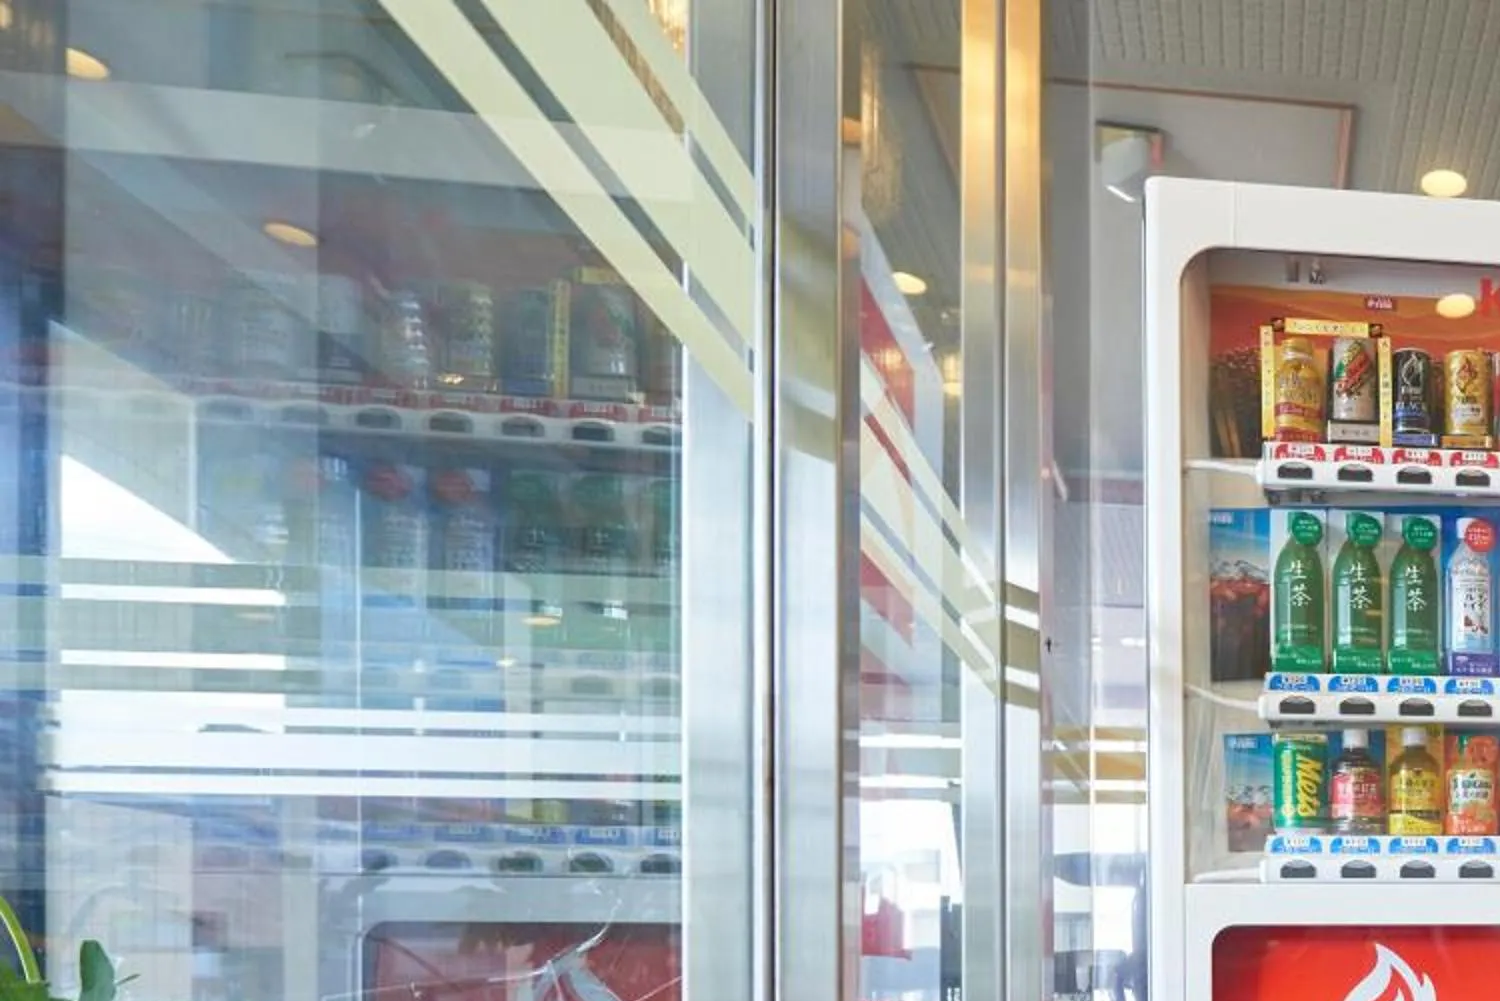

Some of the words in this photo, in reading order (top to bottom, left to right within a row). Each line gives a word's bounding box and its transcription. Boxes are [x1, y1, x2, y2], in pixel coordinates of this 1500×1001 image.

[1287, 559, 1312, 607] 生茶
[1350, 562, 1372, 609] 生茶
[1405, 565, 1427, 612] 生茶
